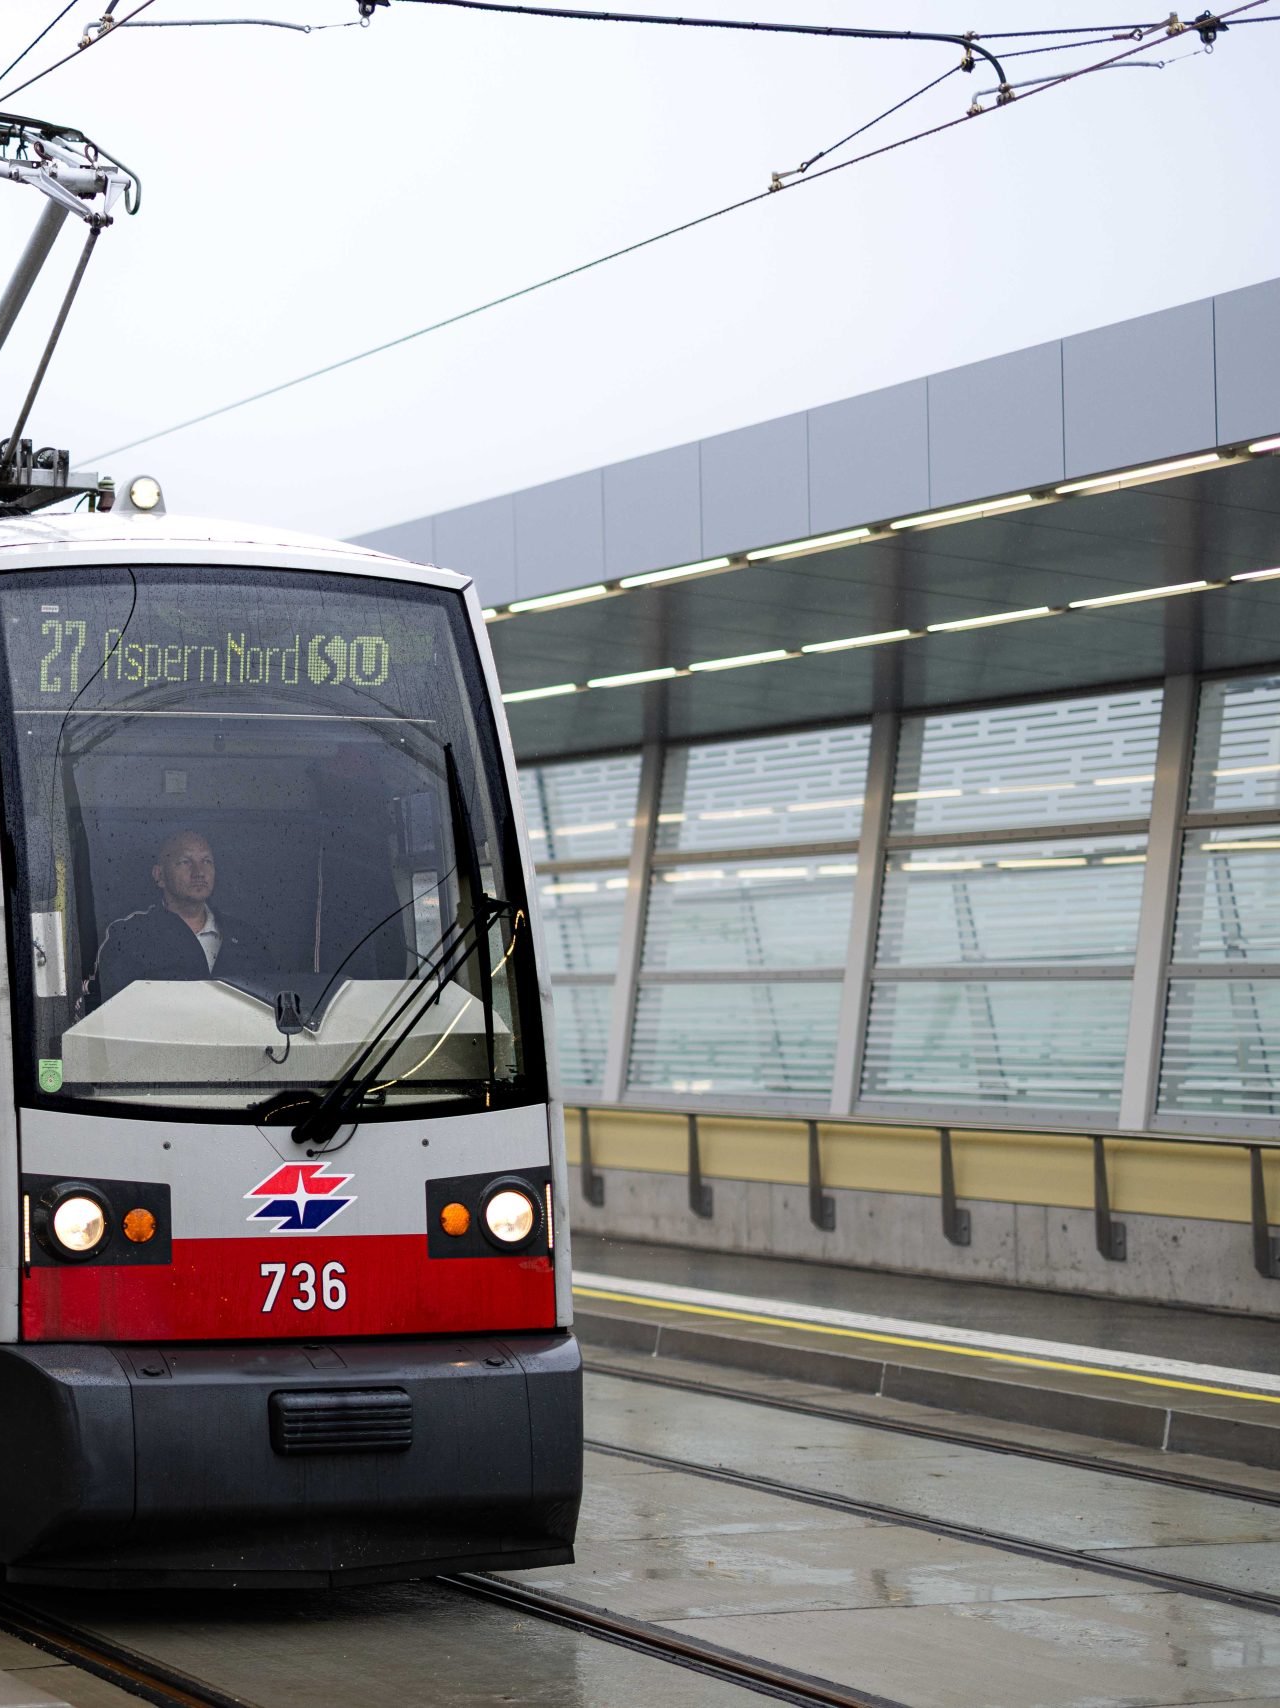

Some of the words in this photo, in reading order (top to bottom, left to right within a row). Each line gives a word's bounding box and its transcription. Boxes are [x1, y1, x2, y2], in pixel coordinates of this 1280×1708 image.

[41, 620, 86, 692] 27
[104, 628, 218, 687] Aspern
[226, 632, 299, 684] Nord
[260, 1261, 347, 1312] 736
